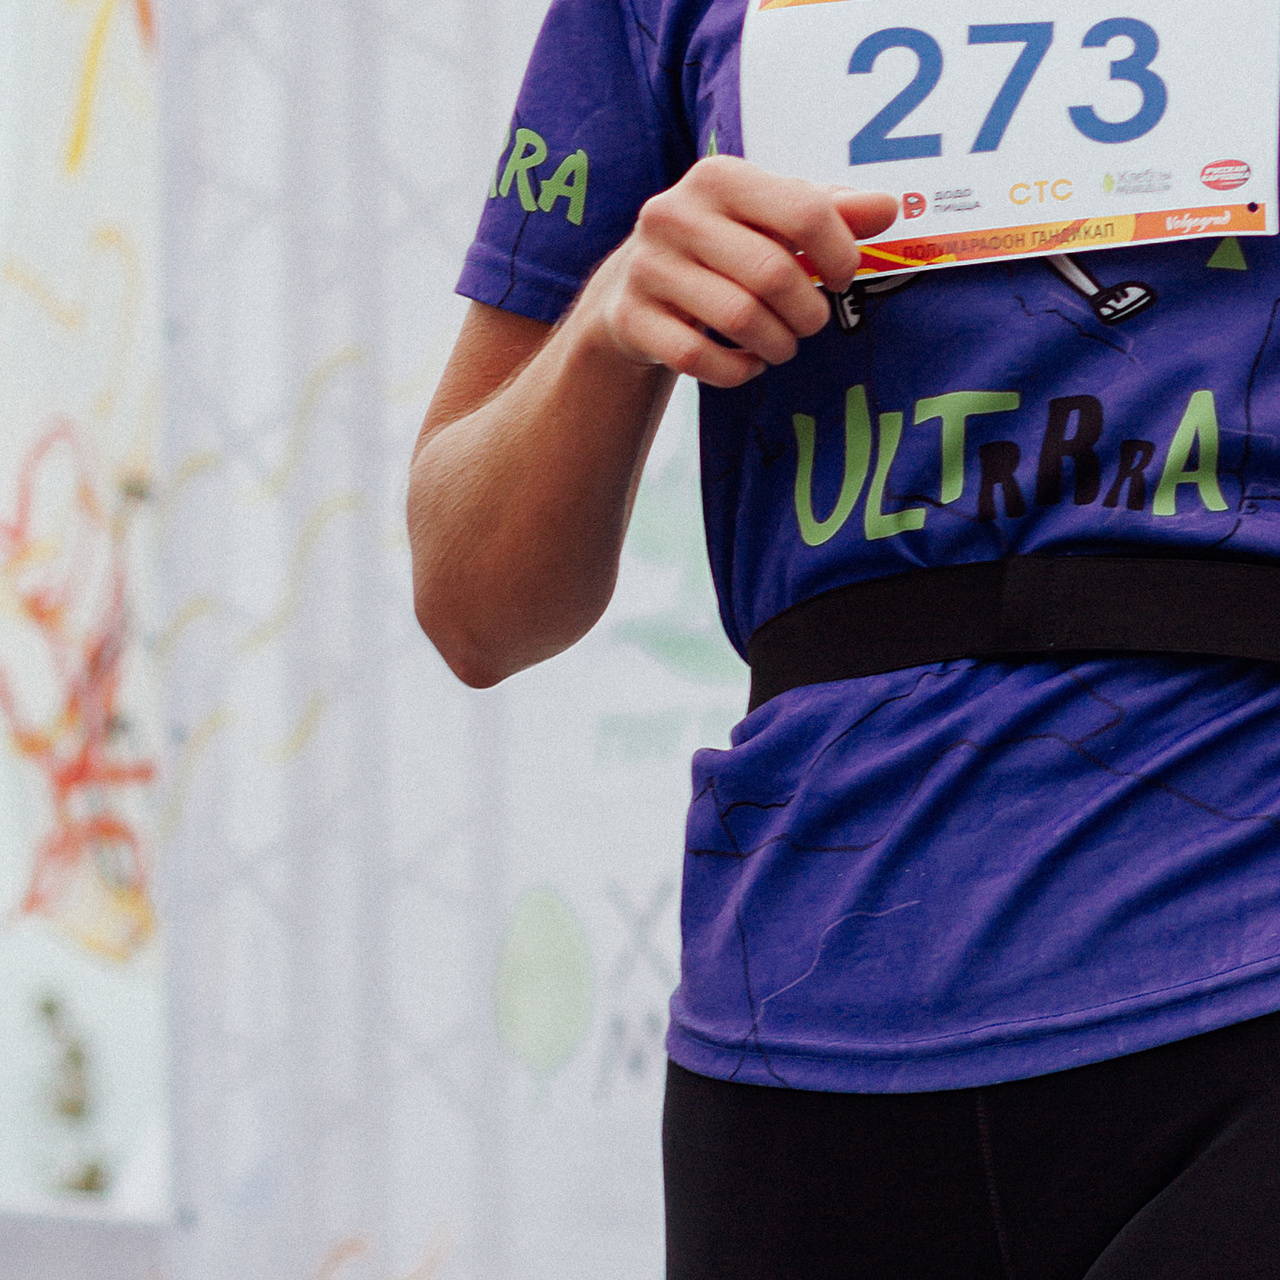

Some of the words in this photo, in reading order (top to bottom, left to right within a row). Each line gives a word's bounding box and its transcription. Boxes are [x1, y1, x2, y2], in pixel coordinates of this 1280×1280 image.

[847, 17, 1168, 167] 273
[902, 233, 1026, 261] ПОЛУМАРАФОН
[1030, 222, 1115, 247] ГАНДИКАП
